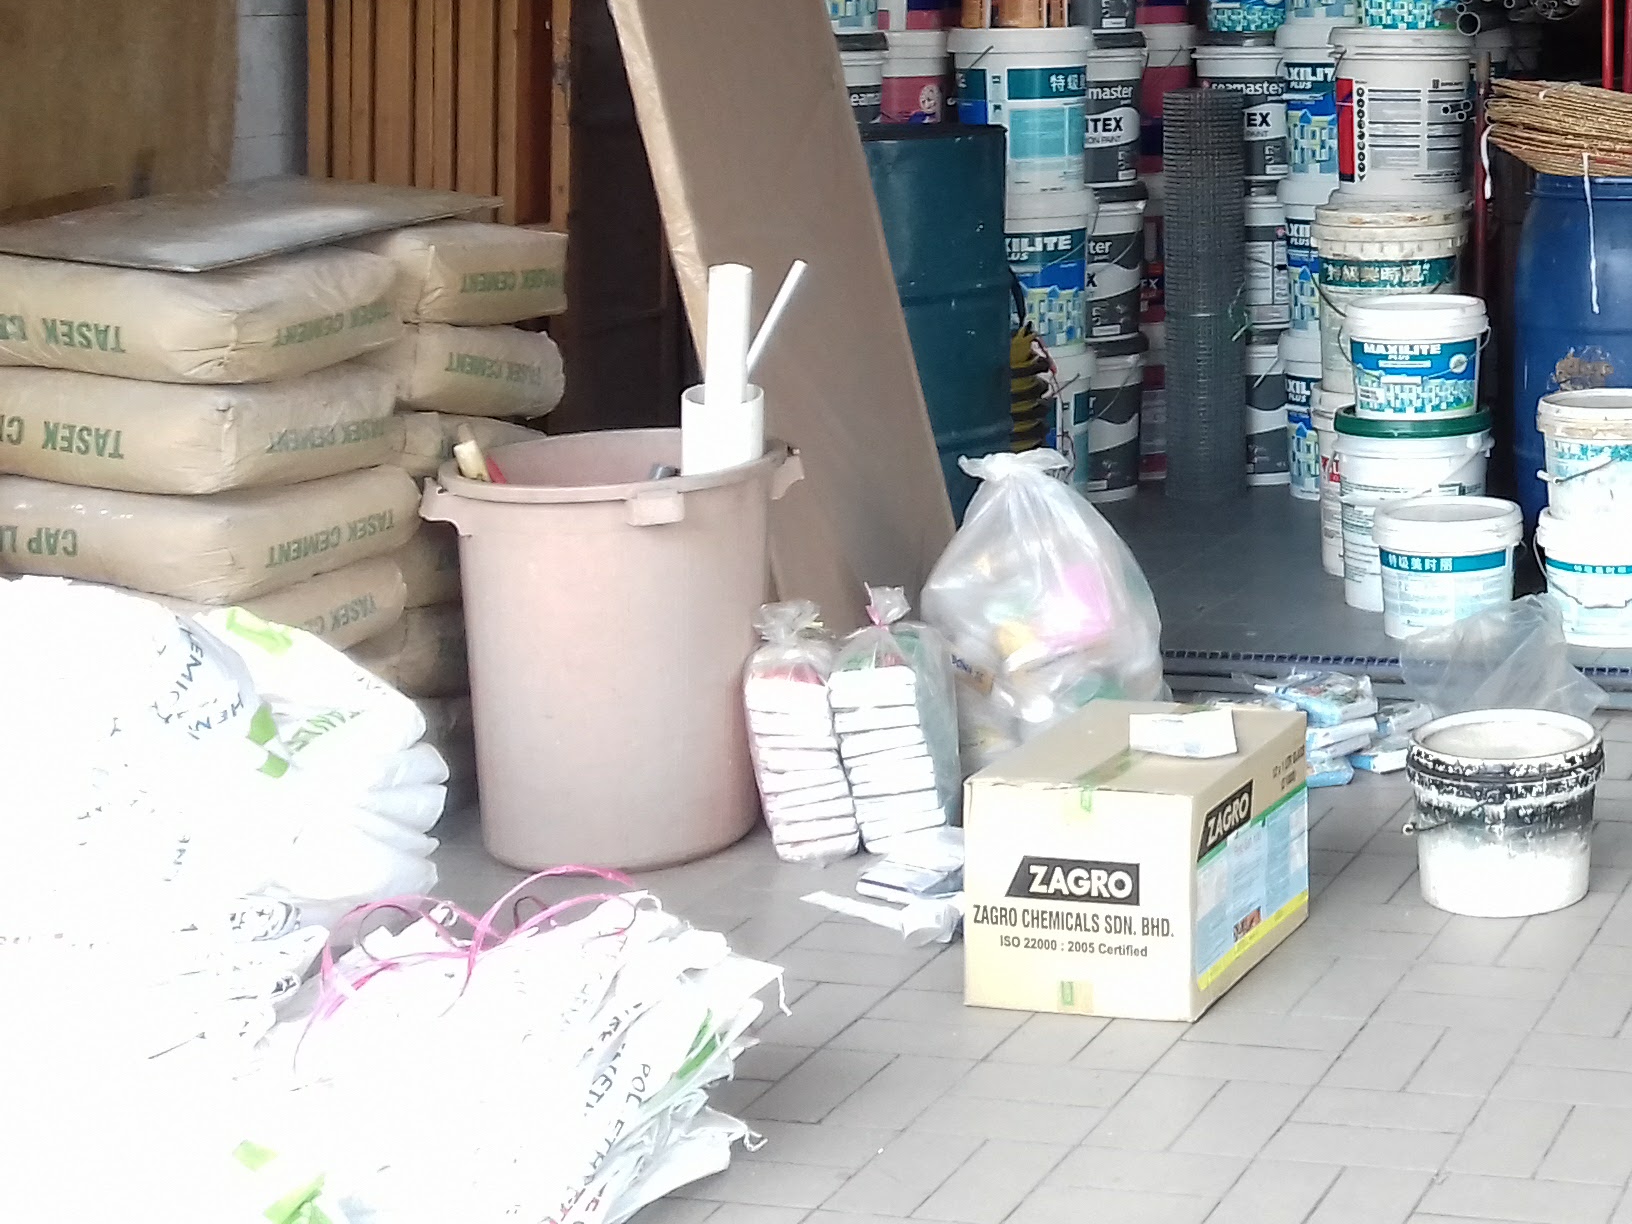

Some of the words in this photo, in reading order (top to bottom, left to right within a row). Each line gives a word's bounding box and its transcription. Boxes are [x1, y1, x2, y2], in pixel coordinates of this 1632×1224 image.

[1088, 86, 1134, 100] master
[1289, 79, 1313, 90] PLUS
[460, 269, 518, 295] CEMENT
[40, 316, 127, 354] TASEK
[272, 309, 342, 348] CEMENT
[1363, 342, 1442, 355] MAXILITE
[445, 351, 503, 381] CEMENT
[40, 420, 126, 461] TASEK
[266, 423, 341, 454] CEMENT
[344, 507, 397, 543] TASEK
[26, 527, 80, 559] CAP
[264, 524, 342, 569] CEMENT
[330, 590, 379, 633] TASEK
[1206, 792, 1250, 847] ZAGRO
[1028, 864, 1133, 899] ZAGRO
[972, 904, 1018, 927] ZAGRO
[1021, 908, 1100, 934] CHEMICALS
[1104, 916, 1137, 936] SDN.
[1141, 917, 1175, 938] BHD.
[999, 935, 1021, 948] ISO
[1023, 936, 1058, 951] 22000
[1067, 940, 1096, 954] 2005
[1098, 942, 1149, 958] Certified
